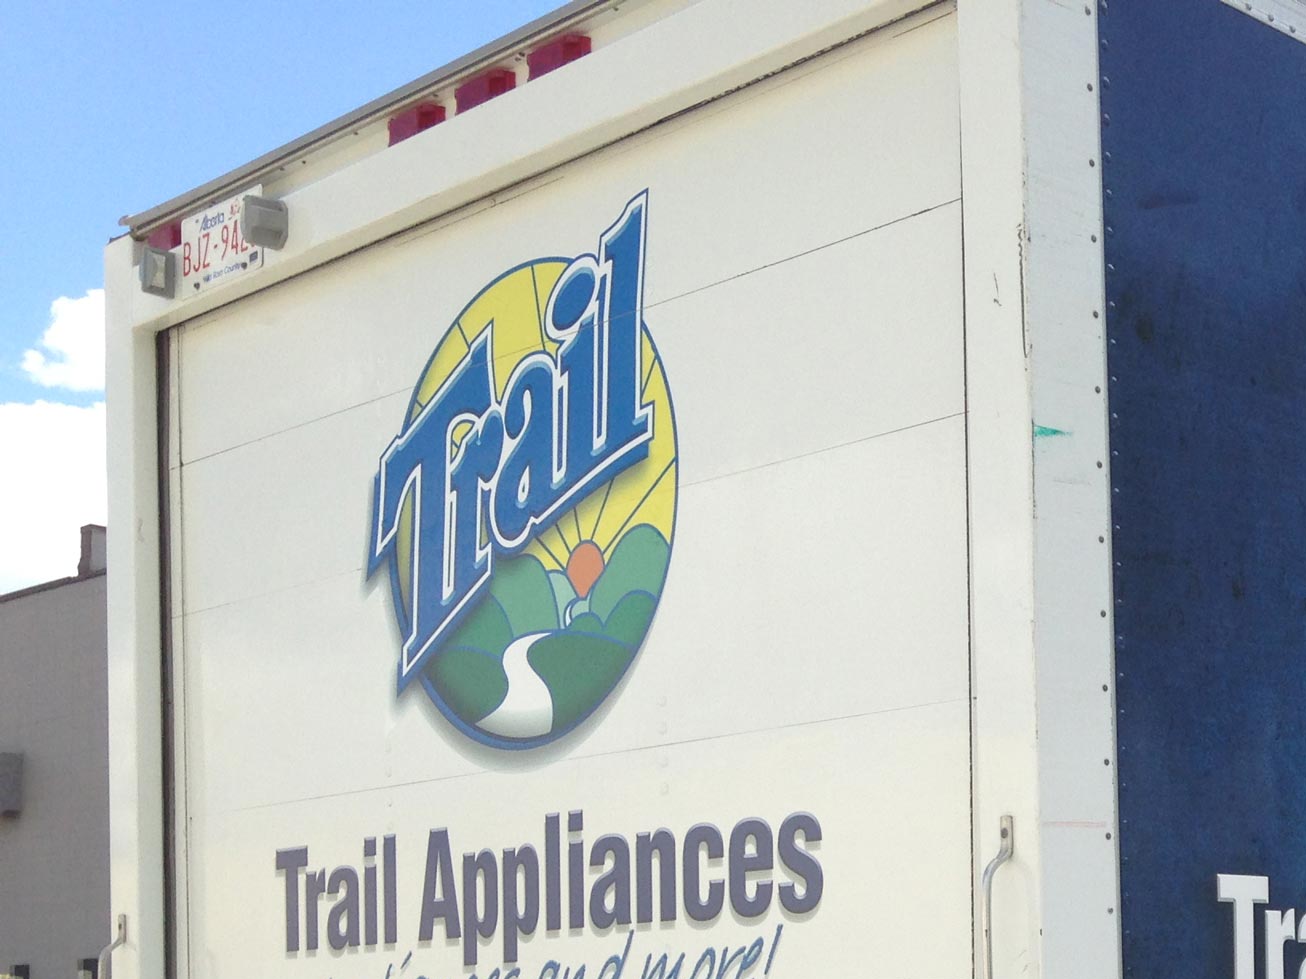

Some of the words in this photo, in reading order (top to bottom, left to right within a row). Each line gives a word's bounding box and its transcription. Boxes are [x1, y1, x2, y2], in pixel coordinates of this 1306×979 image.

[183, 219, 256, 277] BJZ-94
[366, 188, 655, 698] Trail
[275, 833, 398, 953] Trail
[418, 809, 824, 967] Appliances
